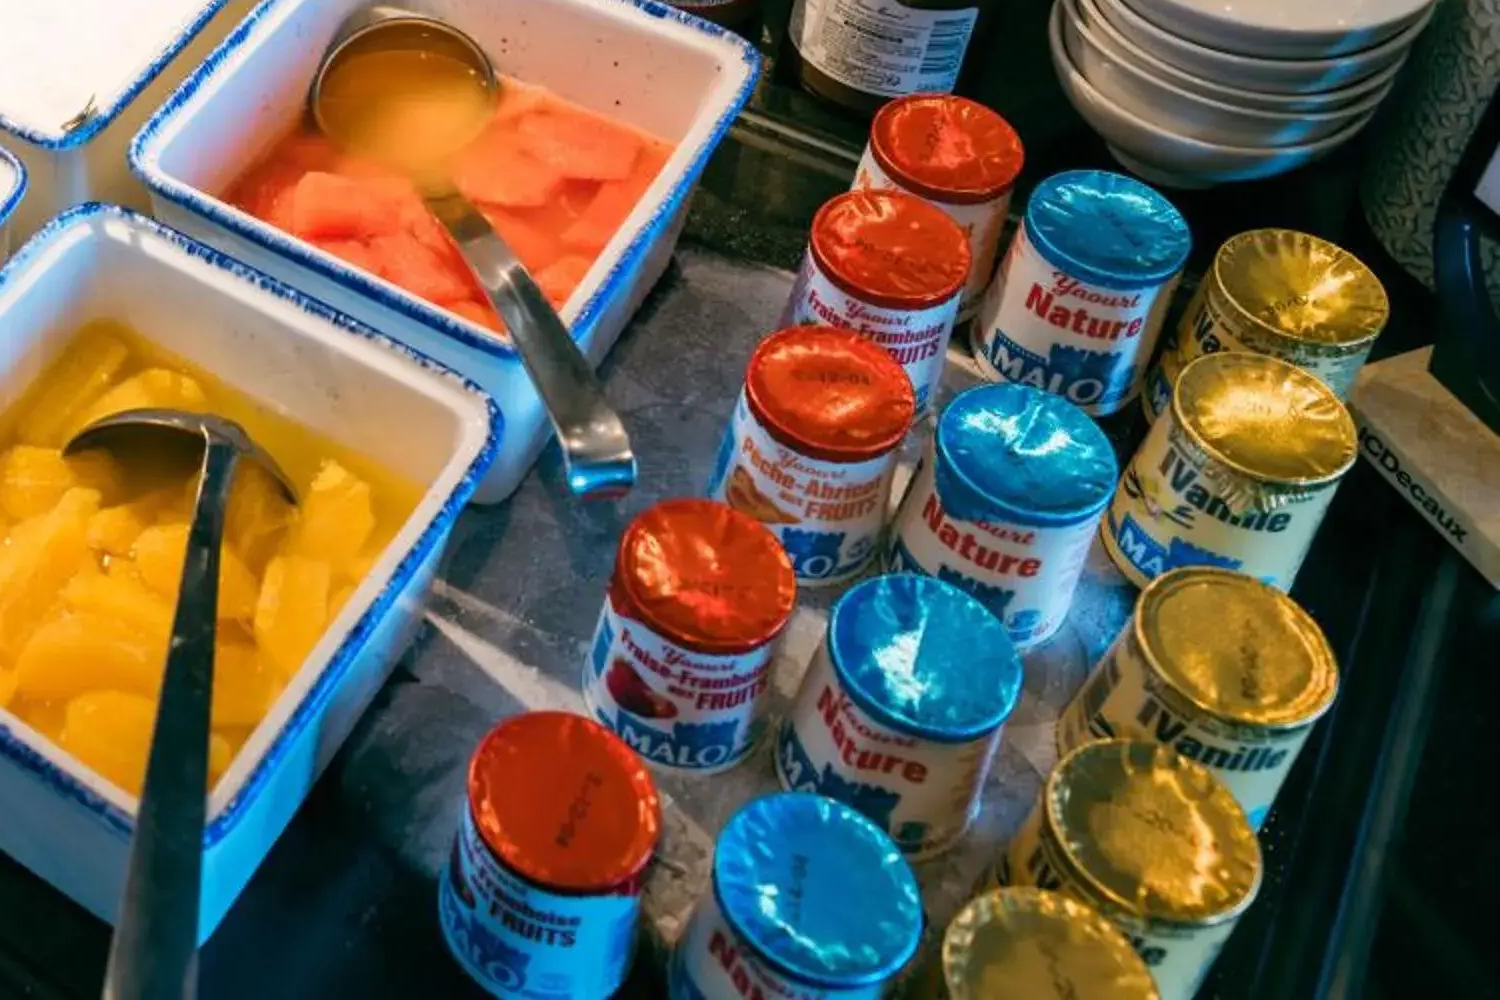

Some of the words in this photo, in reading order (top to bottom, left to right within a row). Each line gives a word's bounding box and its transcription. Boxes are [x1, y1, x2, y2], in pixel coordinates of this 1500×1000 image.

[1025, 282, 1143, 341] Nature
[1052, 271, 1142, 309] Yaourt
[922, 492, 1043, 578] Nature
[622, 723, 729, 767] MALO
[817, 685, 929, 785] Nature
[489, 902, 577, 949] FRUITS
